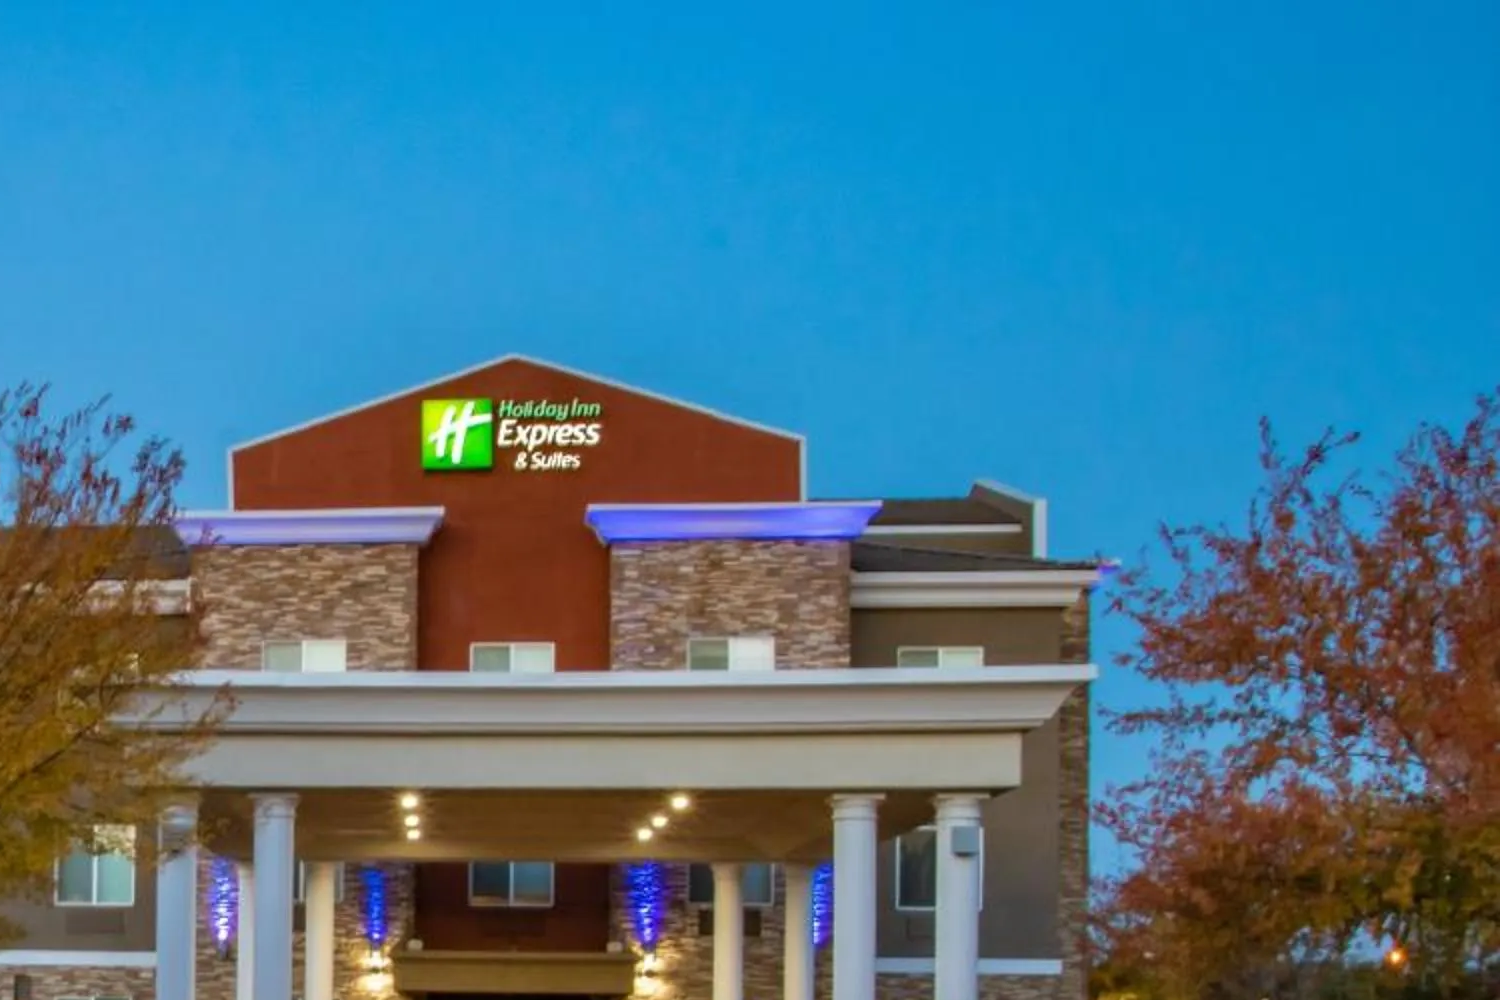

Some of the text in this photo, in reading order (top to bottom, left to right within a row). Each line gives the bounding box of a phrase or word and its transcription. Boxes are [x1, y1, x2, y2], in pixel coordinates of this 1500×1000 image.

[499, 397, 601, 420] Holiday Inn
[497, 418, 601, 451] Express
[514, 451, 581, 470] & Suites
